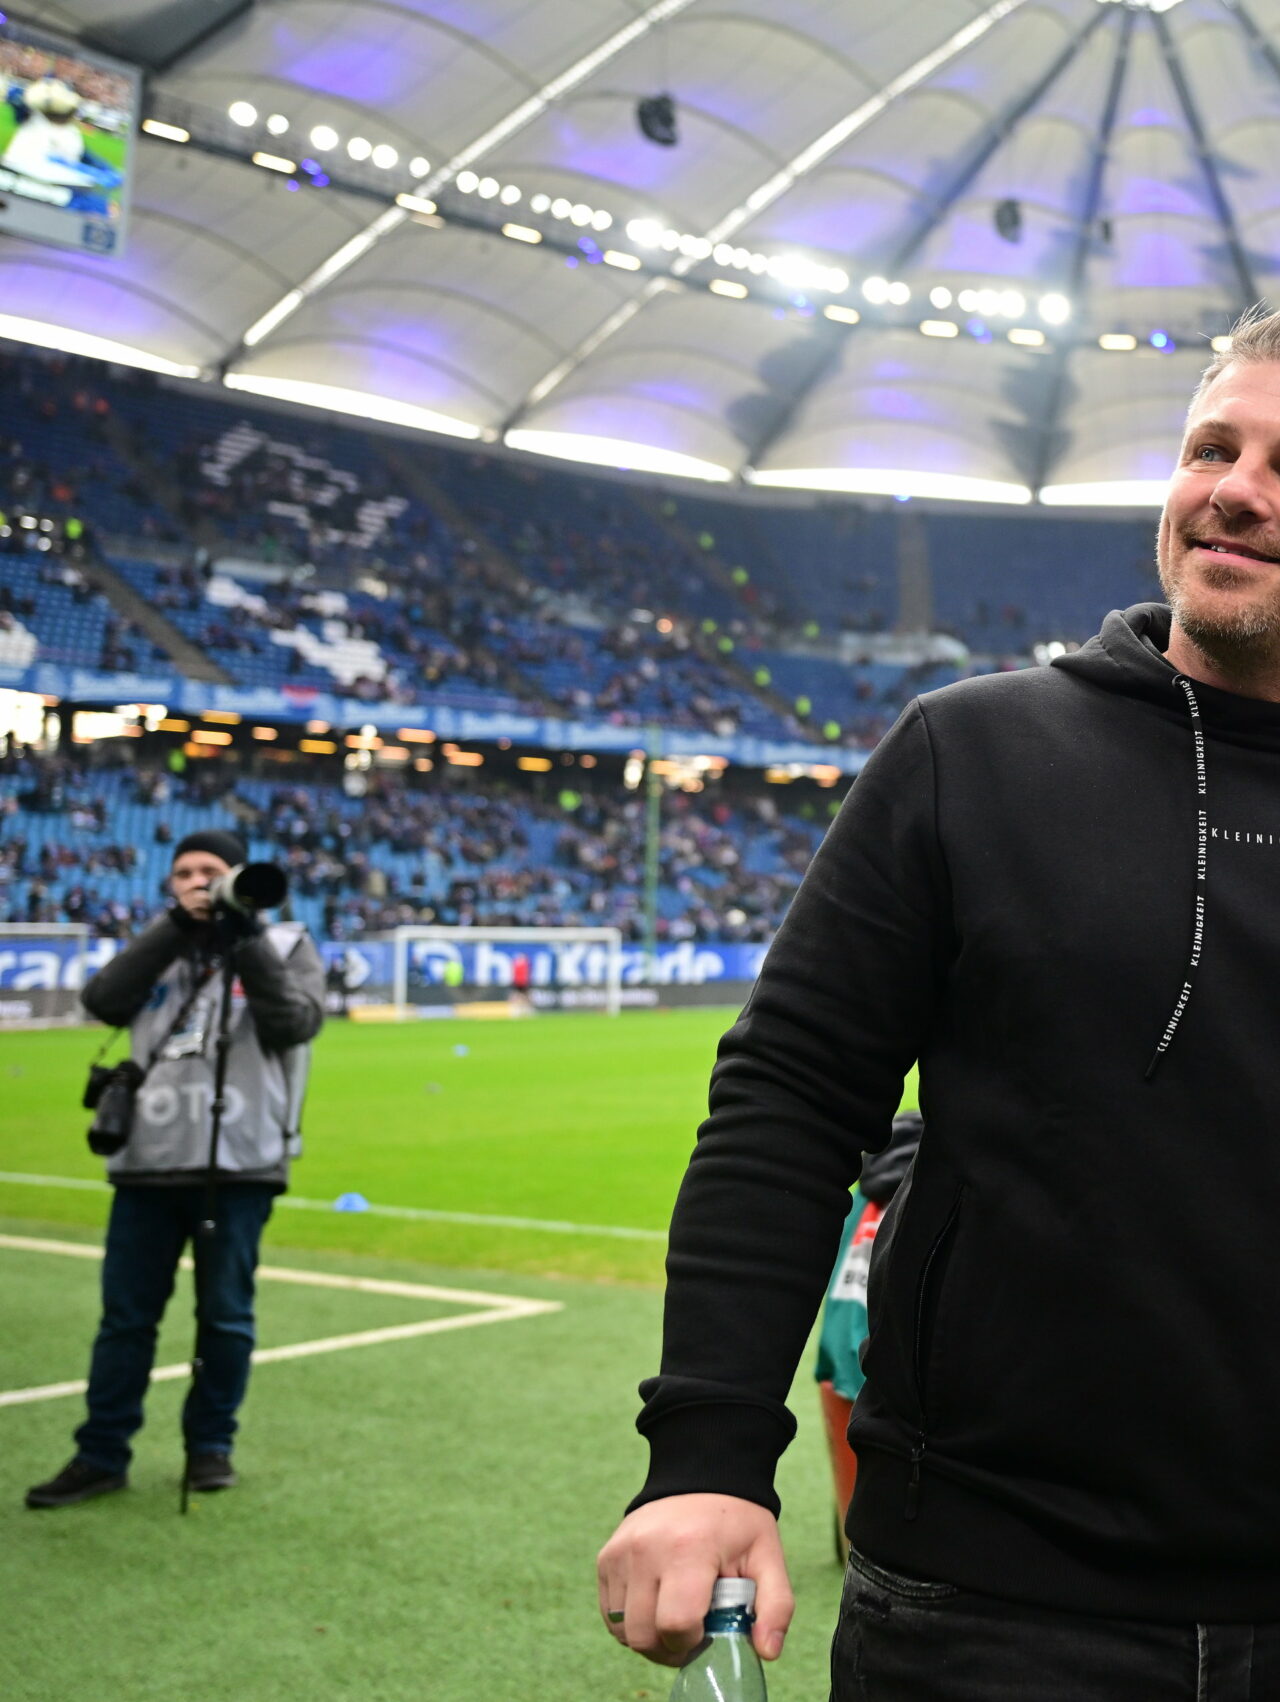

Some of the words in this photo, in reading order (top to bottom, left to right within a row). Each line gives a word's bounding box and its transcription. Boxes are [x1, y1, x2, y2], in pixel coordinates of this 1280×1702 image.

[1194, 730, 1207, 795] KLEINIGKEIT
[1197, 810, 1207, 880] KLEINIGKEIT
[1190, 895, 1205, 967] KLEINIGKEIT
